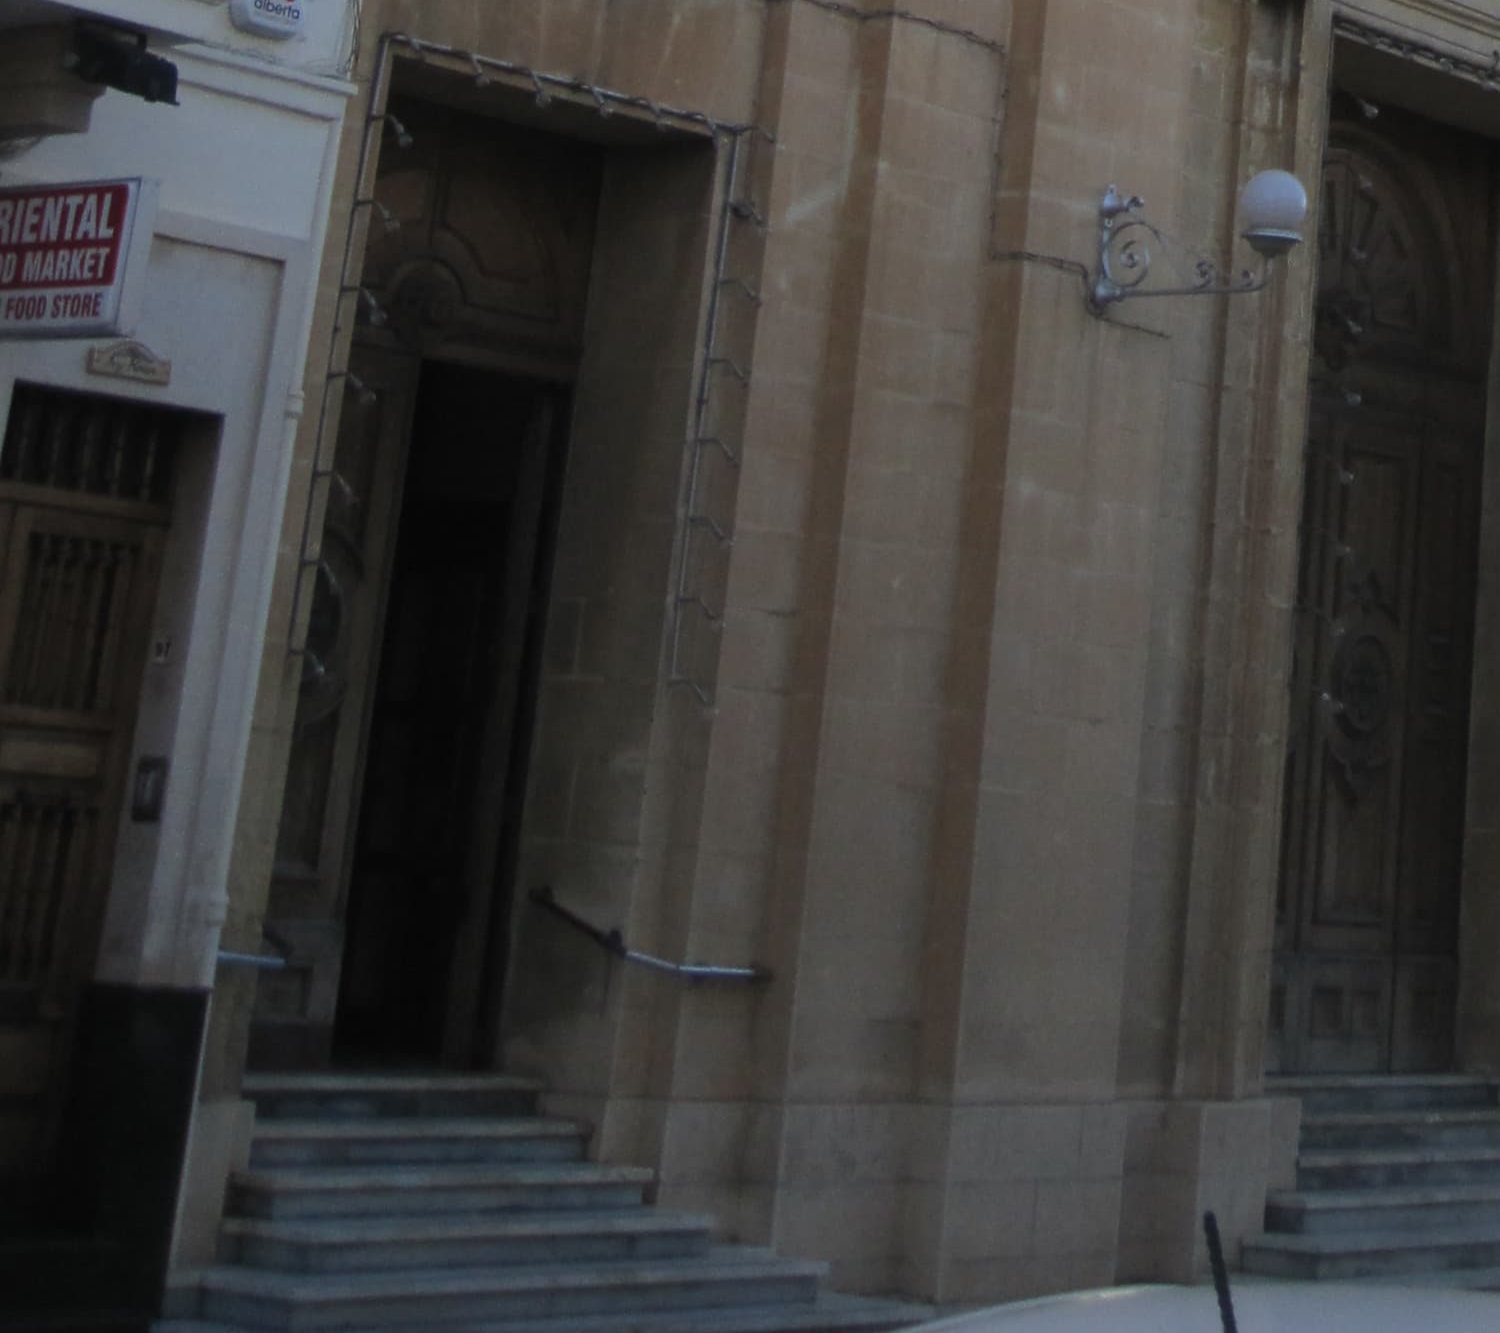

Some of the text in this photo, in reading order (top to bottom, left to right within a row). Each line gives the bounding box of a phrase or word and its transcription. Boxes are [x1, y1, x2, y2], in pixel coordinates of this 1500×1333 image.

[22, 247, 110, 283] MARKET
[5, 291, 104, 320] FOOD STORE
